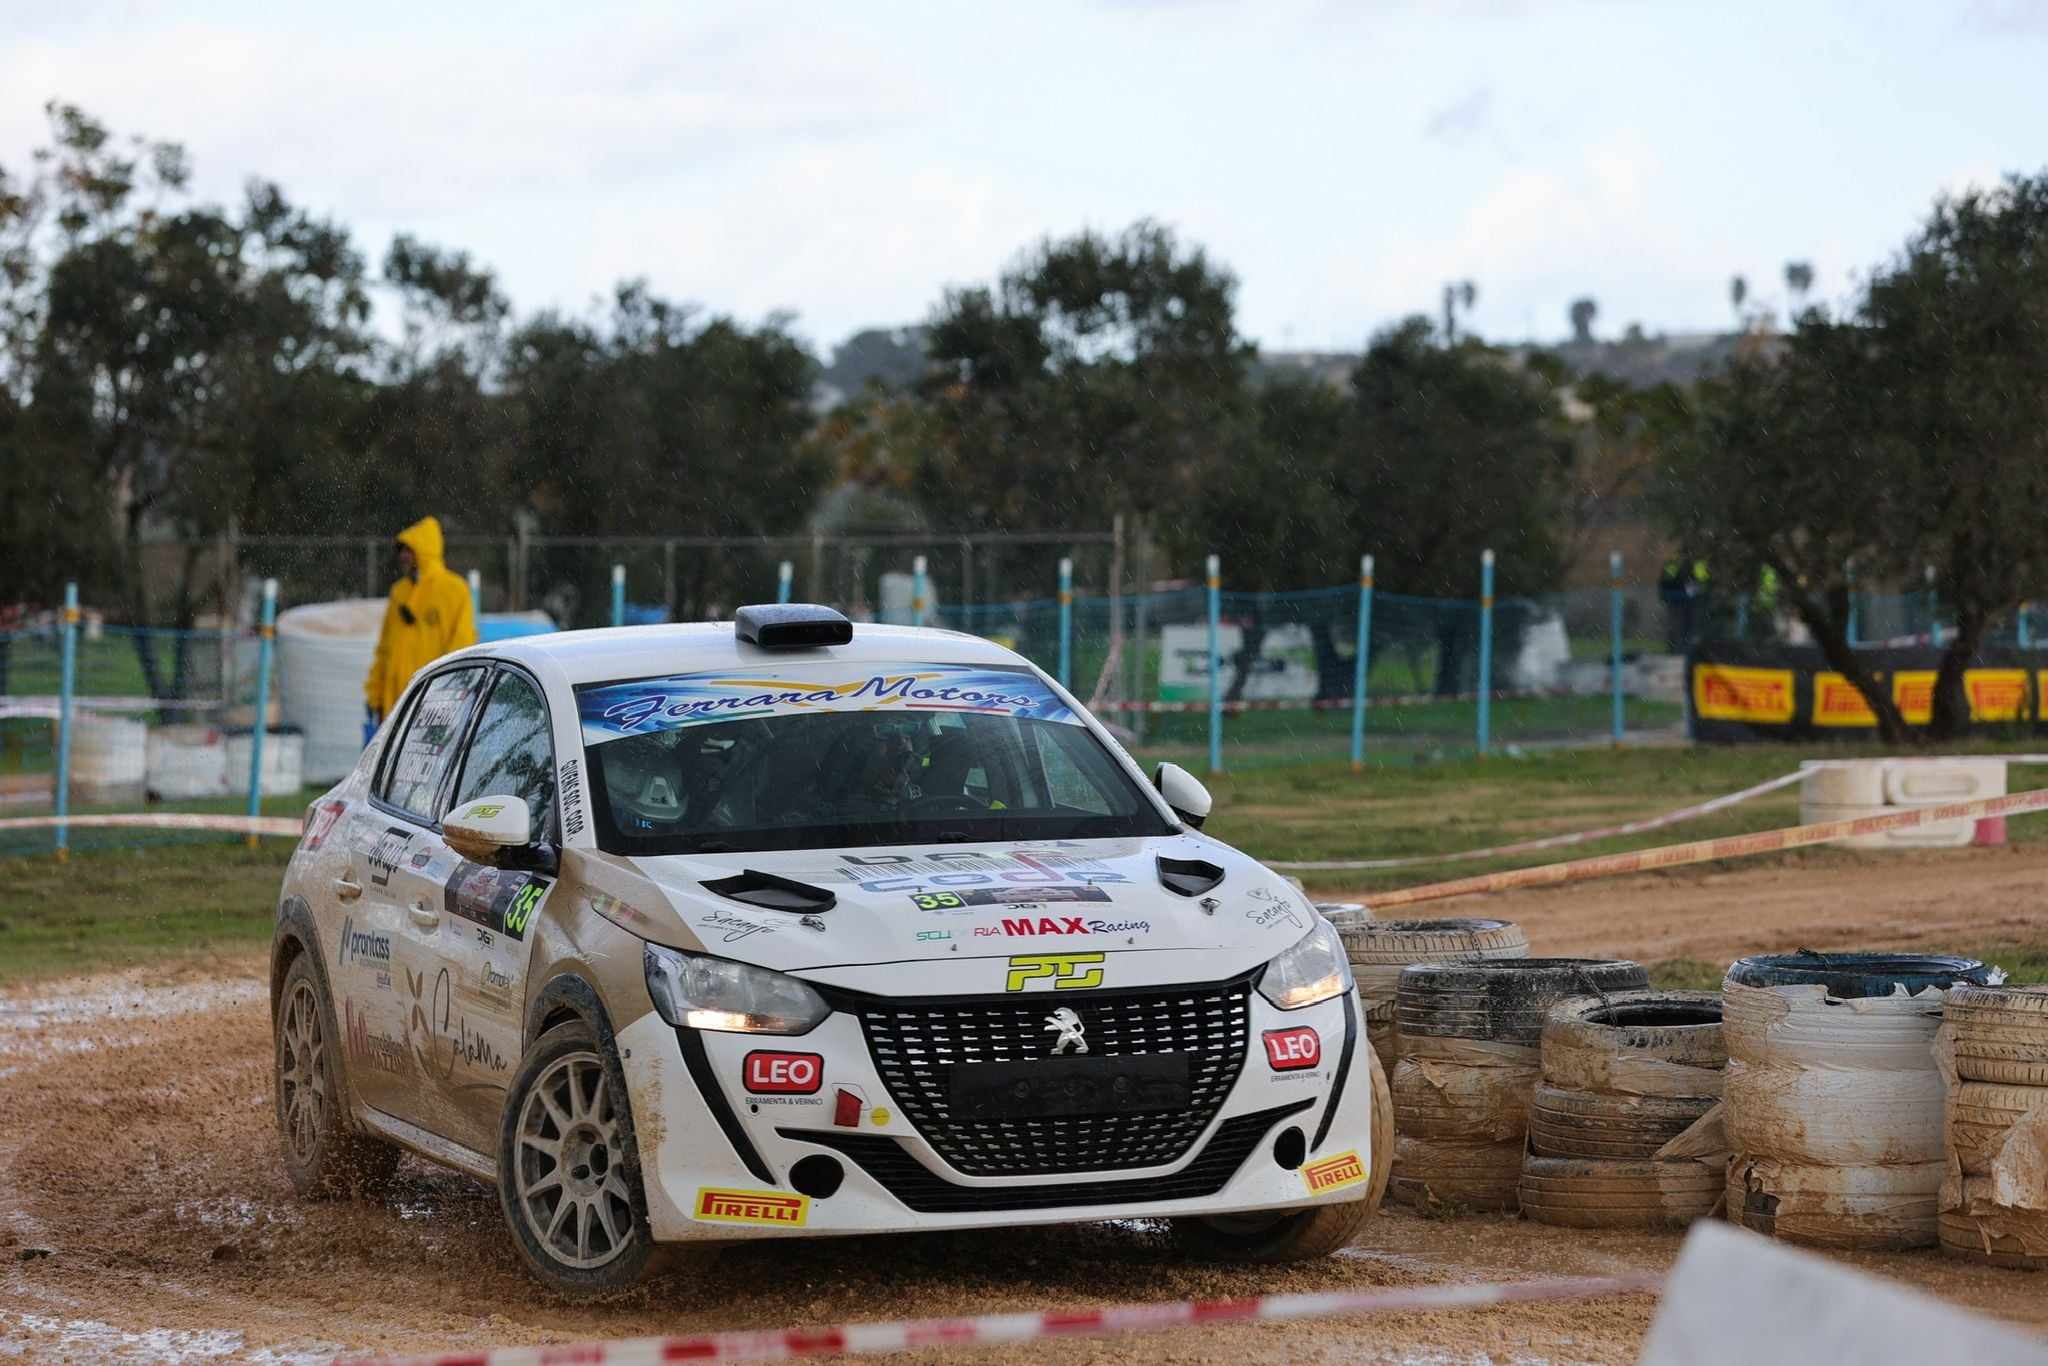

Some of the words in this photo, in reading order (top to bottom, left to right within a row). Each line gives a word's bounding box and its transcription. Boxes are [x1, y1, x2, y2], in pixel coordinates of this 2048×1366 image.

[604, 689, 841, 731] Ferrara
[850, 676, 1040, 707] Motors
[507, 884, 544, 932] 35
[912, 892, 960, 910] 35
[1001, 917, 1090, 936] MAX
[1088, 920, 1150, 934] Racing
[1271, 1034, 1316, 1061] LEO
[753, 1059, 814, 1084] LEO
[1305, 1155, 1363, 1190] PIRELLI
[701, 1192, 802, 1221] PIRELLI
